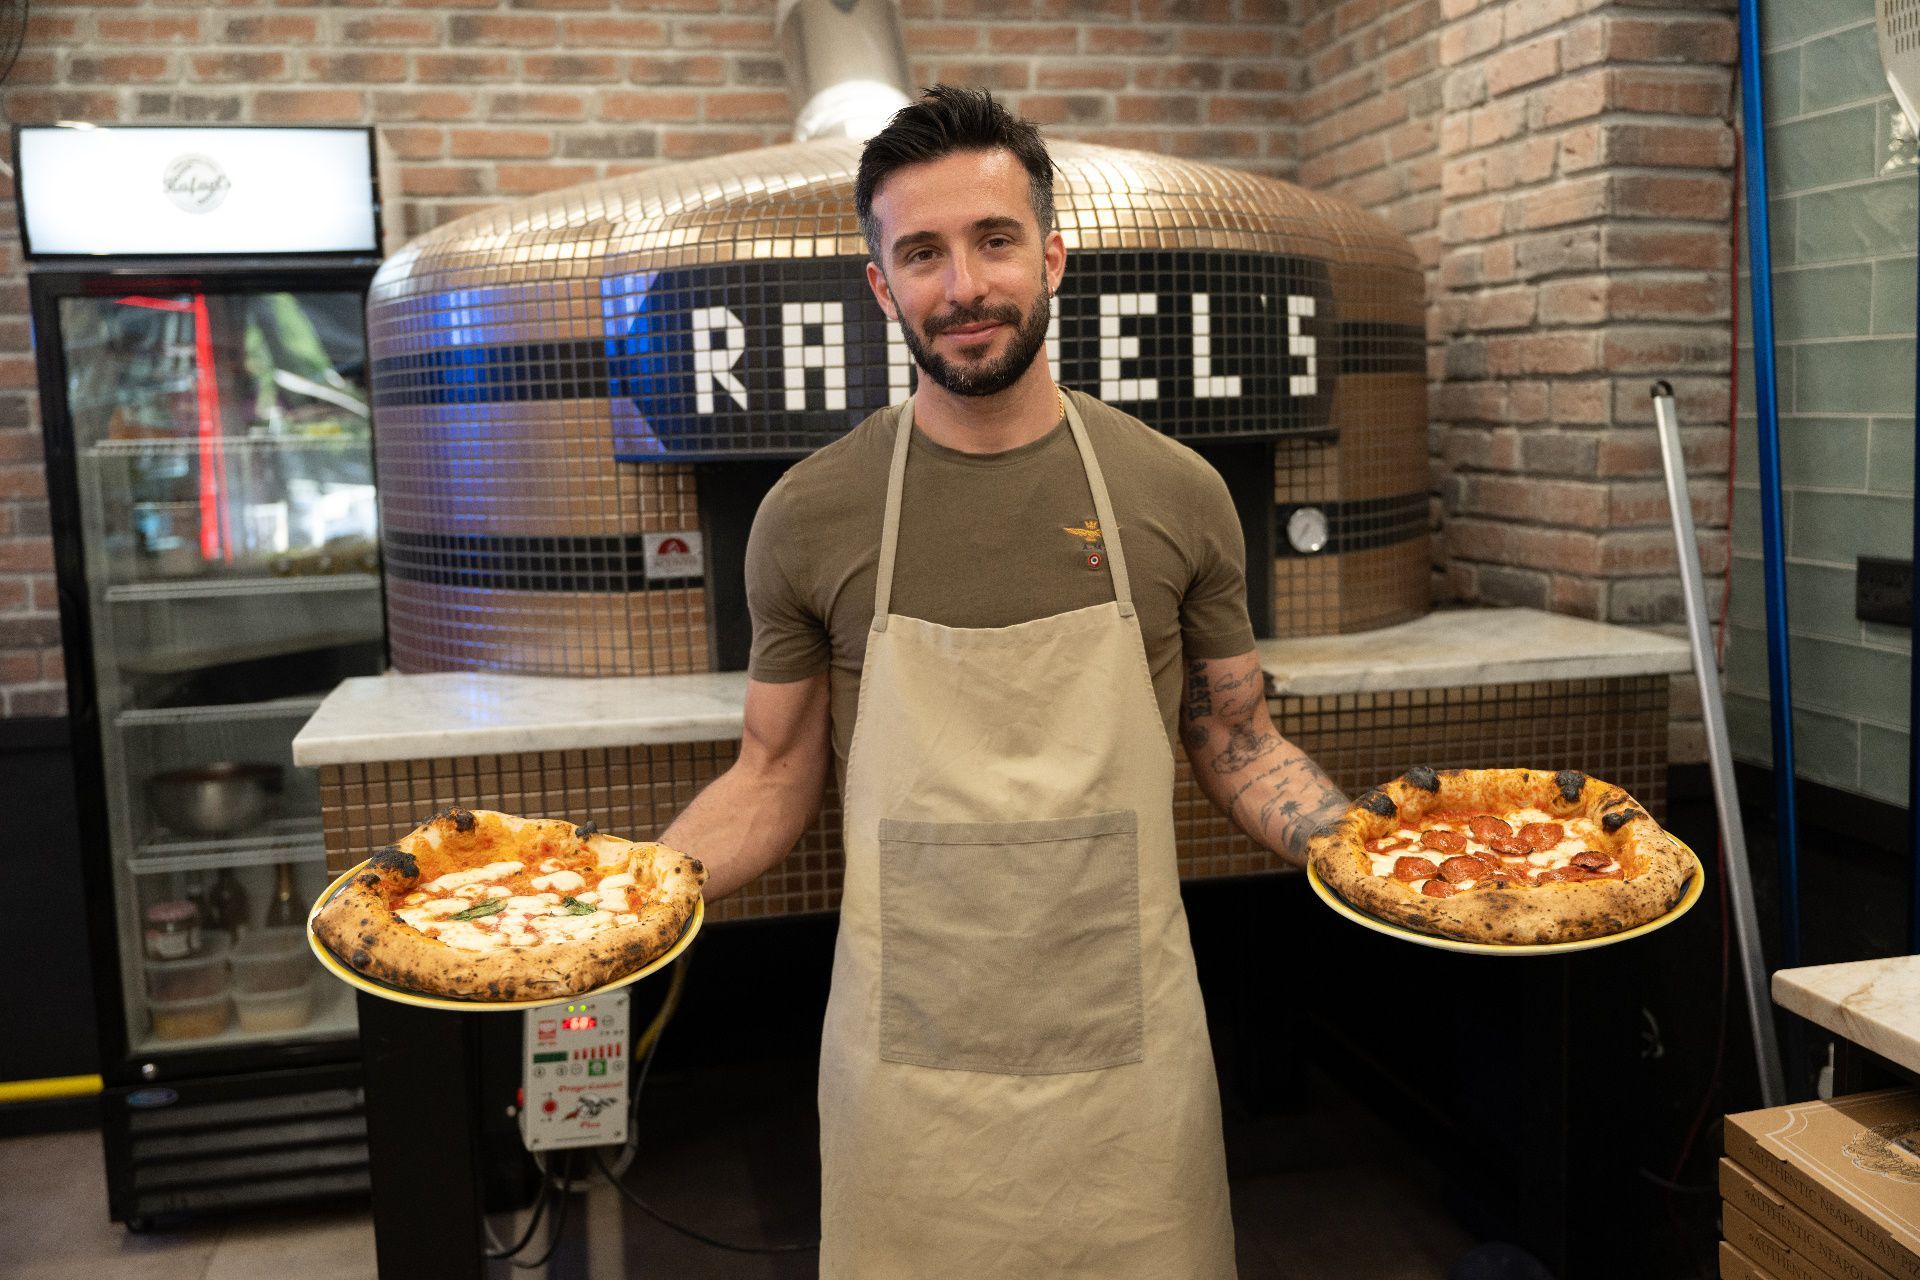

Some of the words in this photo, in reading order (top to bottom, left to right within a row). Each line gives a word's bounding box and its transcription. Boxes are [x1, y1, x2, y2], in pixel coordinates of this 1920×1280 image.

[692, 293, 1317, 414] RAEL'S
[1819, 1241, 1870, 1280] NEAPOL
[1820, 1196, 1896, 1261] NEAPOLITAN
